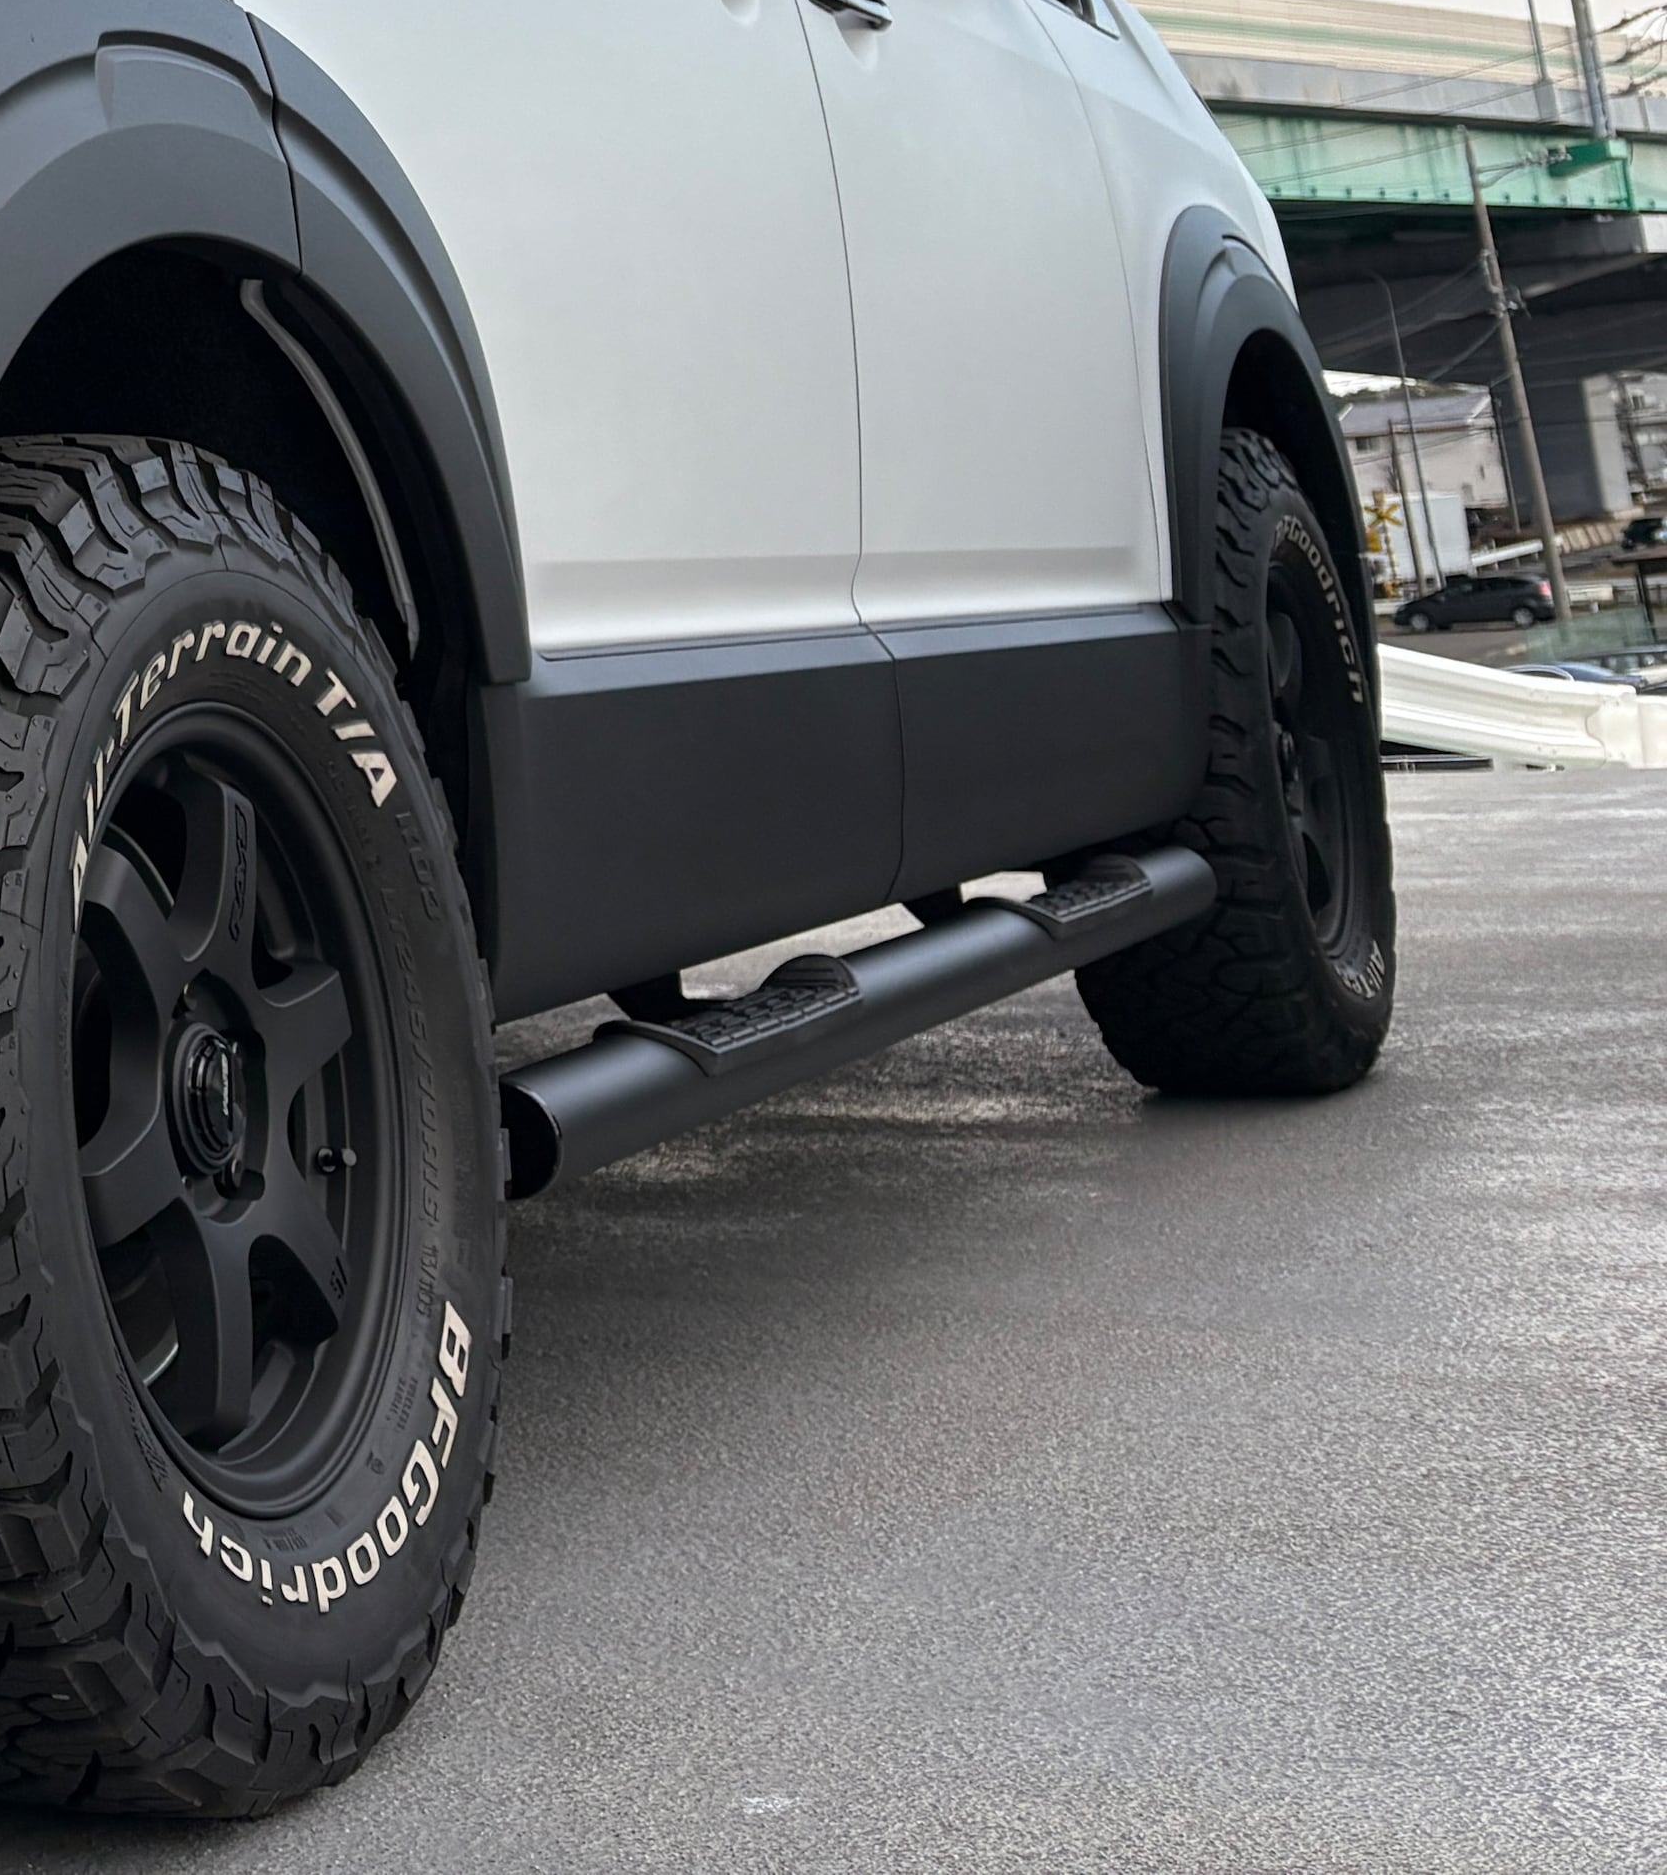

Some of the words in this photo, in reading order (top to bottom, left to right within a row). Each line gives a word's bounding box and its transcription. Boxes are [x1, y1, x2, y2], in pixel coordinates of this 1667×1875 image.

[69, 618, 313, 933] All-Terrain
[313, 668, 399, 809] T/A
[182, 1299, 474, 1614] BFGoodrich
